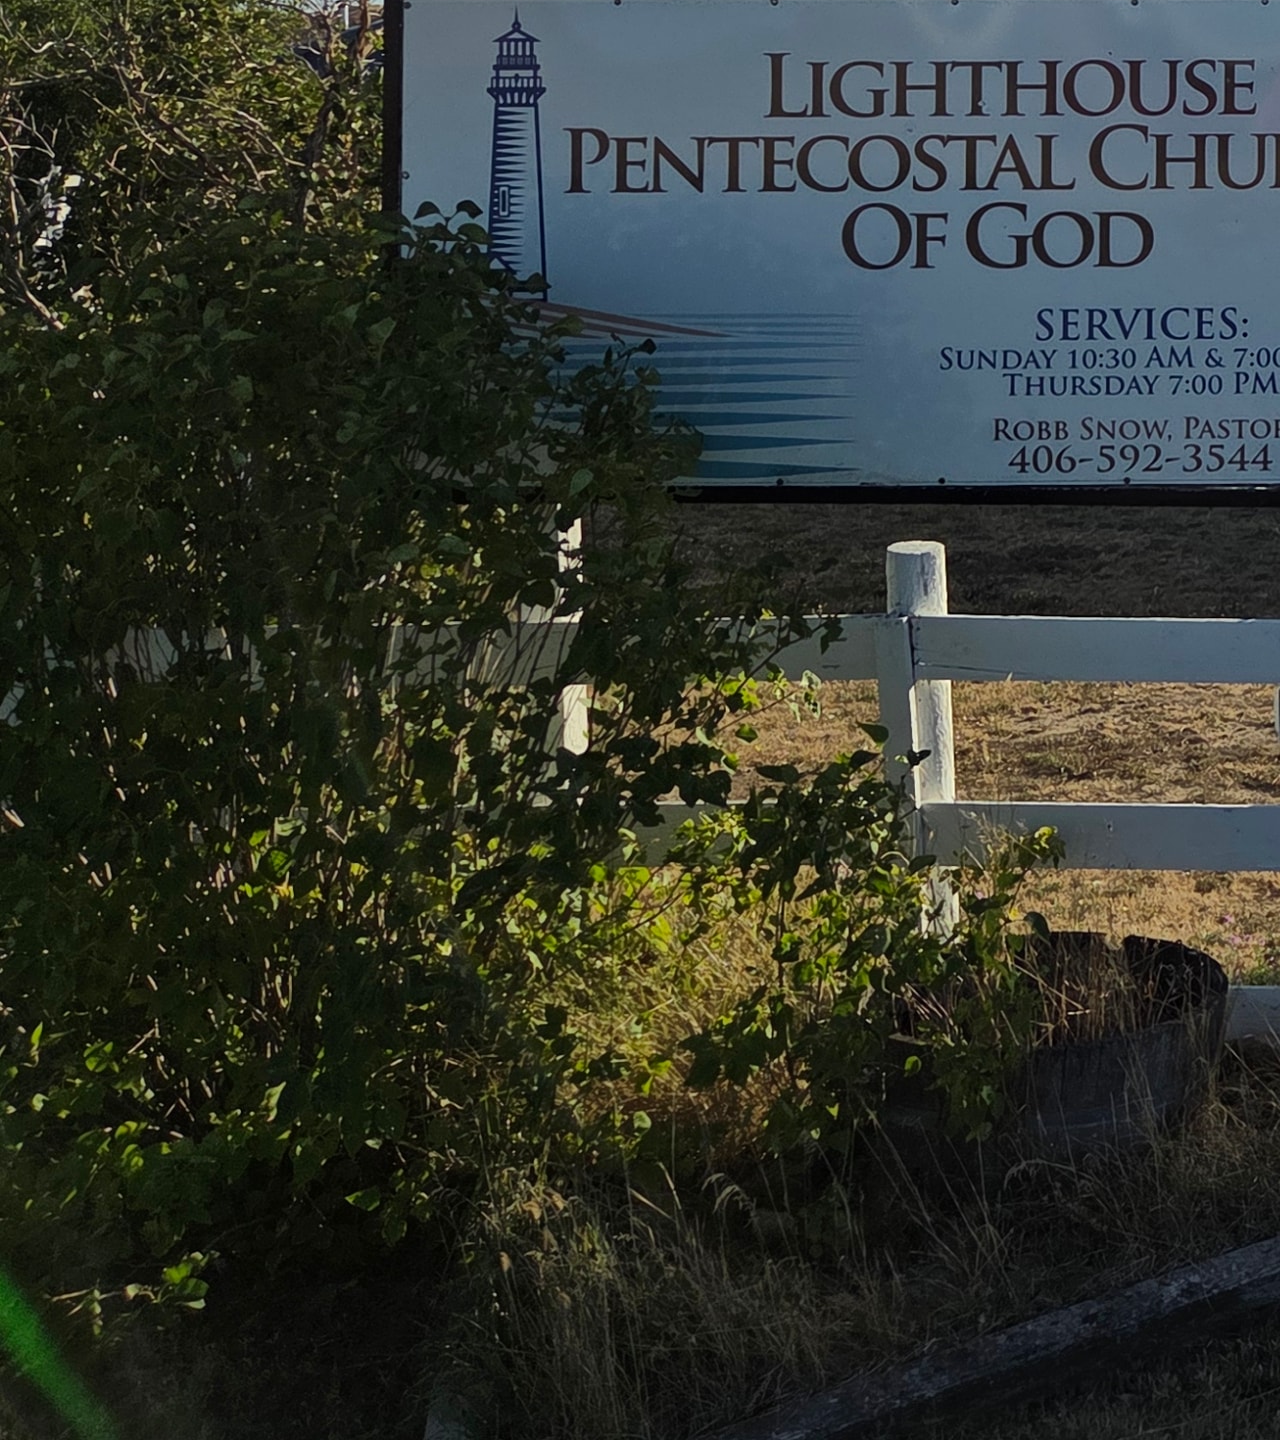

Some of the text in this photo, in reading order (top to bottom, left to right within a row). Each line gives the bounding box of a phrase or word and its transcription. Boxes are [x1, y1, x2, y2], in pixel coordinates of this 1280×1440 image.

[763, 53, 1257, 118] LIGHTHOUSE
[563, 128, 1077, 193] PENTECOSTAL
[842, 202, 1154, 270] OF GOD
[1036, 307, 1248, 341] SERVICES:
[940, 347, 1058, 370] SUNDAY
[1068, 348, 1136, 369] 10:30
[1144, 345, 1195, 368] AM
[1205, 348, 1226, 368] &
[1003, 371, 1279, 396] THURSDAY 7:00 PM
[994, 418, 1068, 441] ROBB
[1080, 417, 1172, 442] SNOW,
[1008, 444, 1273, 473] 406-592-3544
